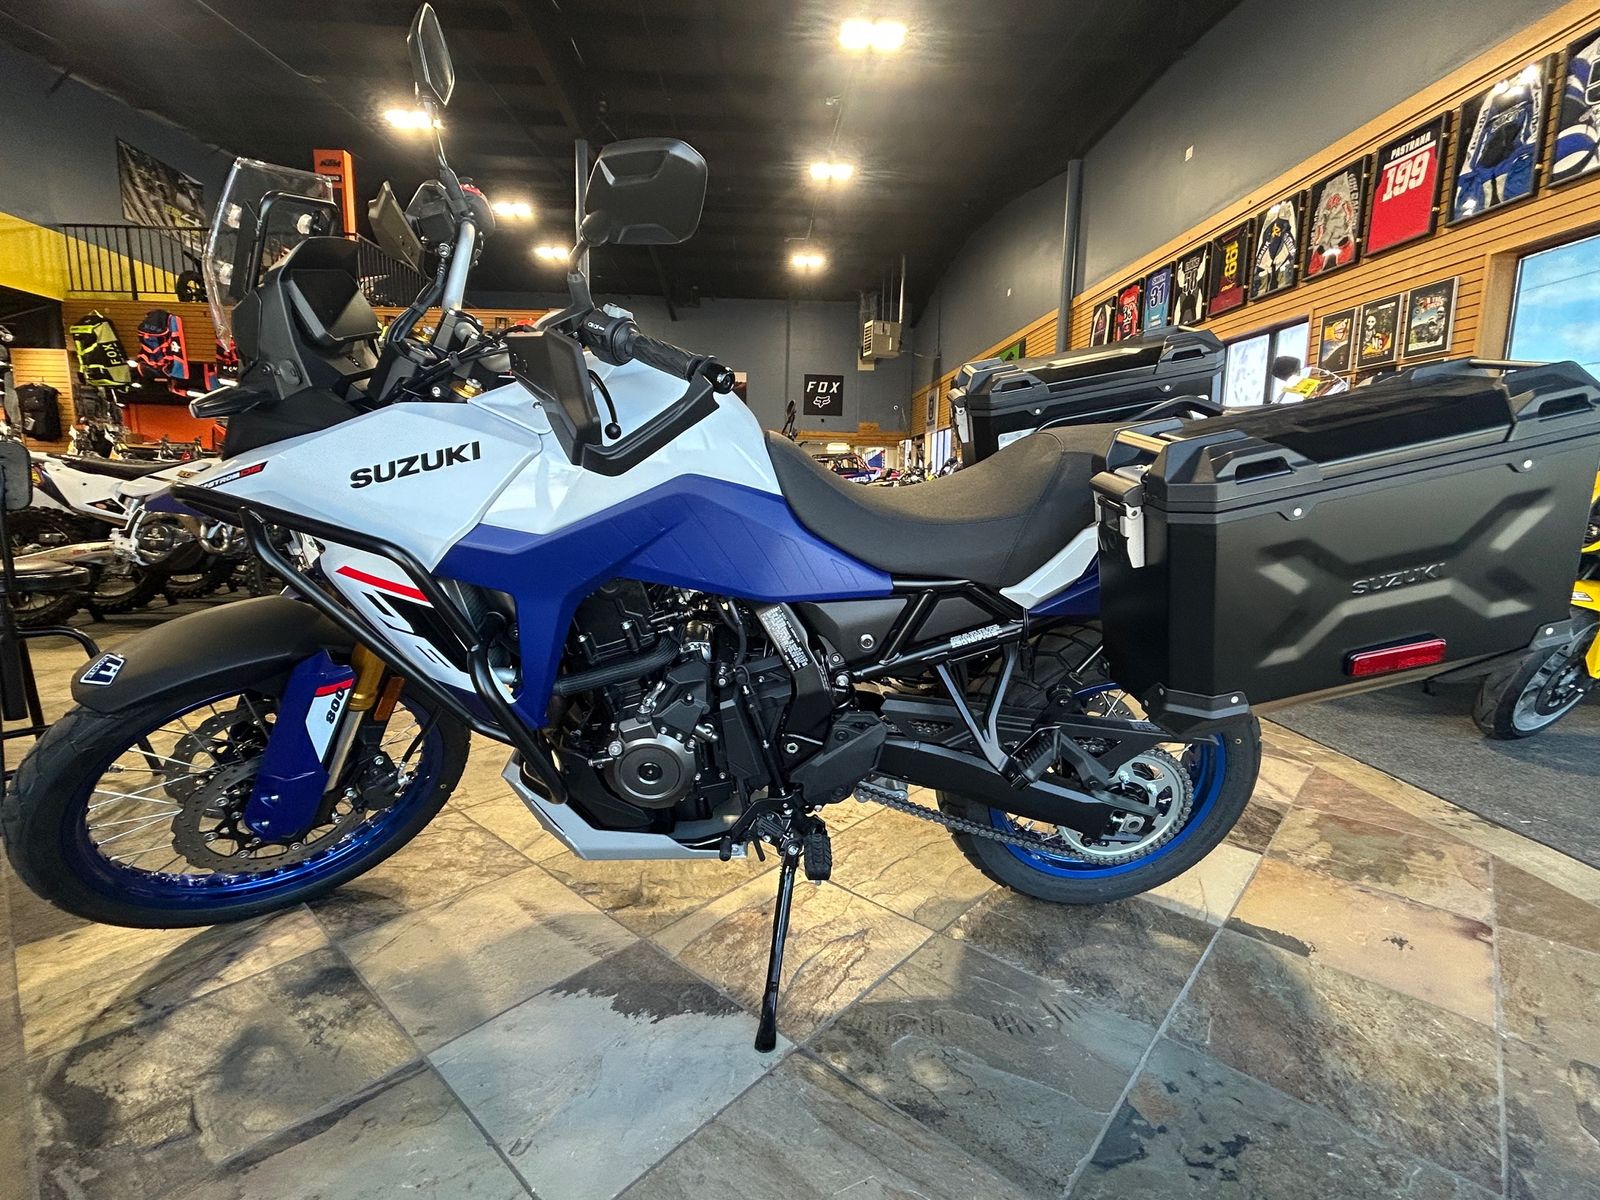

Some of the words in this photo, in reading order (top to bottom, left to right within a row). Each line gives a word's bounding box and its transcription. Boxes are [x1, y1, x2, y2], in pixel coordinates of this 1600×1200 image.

[1390, 131, 1432, 160] PASTRANA
[1382, 150, 1430, 202] 199
[1150, 282, 1166, 309] 31
[102, 343, 121, 365] FOX
[806, 381, 840, 393] FOX
[350, 440, 481, 489] SUZUKI
[1351, 562, 1446, 595] SUZUKI
[326, 687, 345, 724] 800
